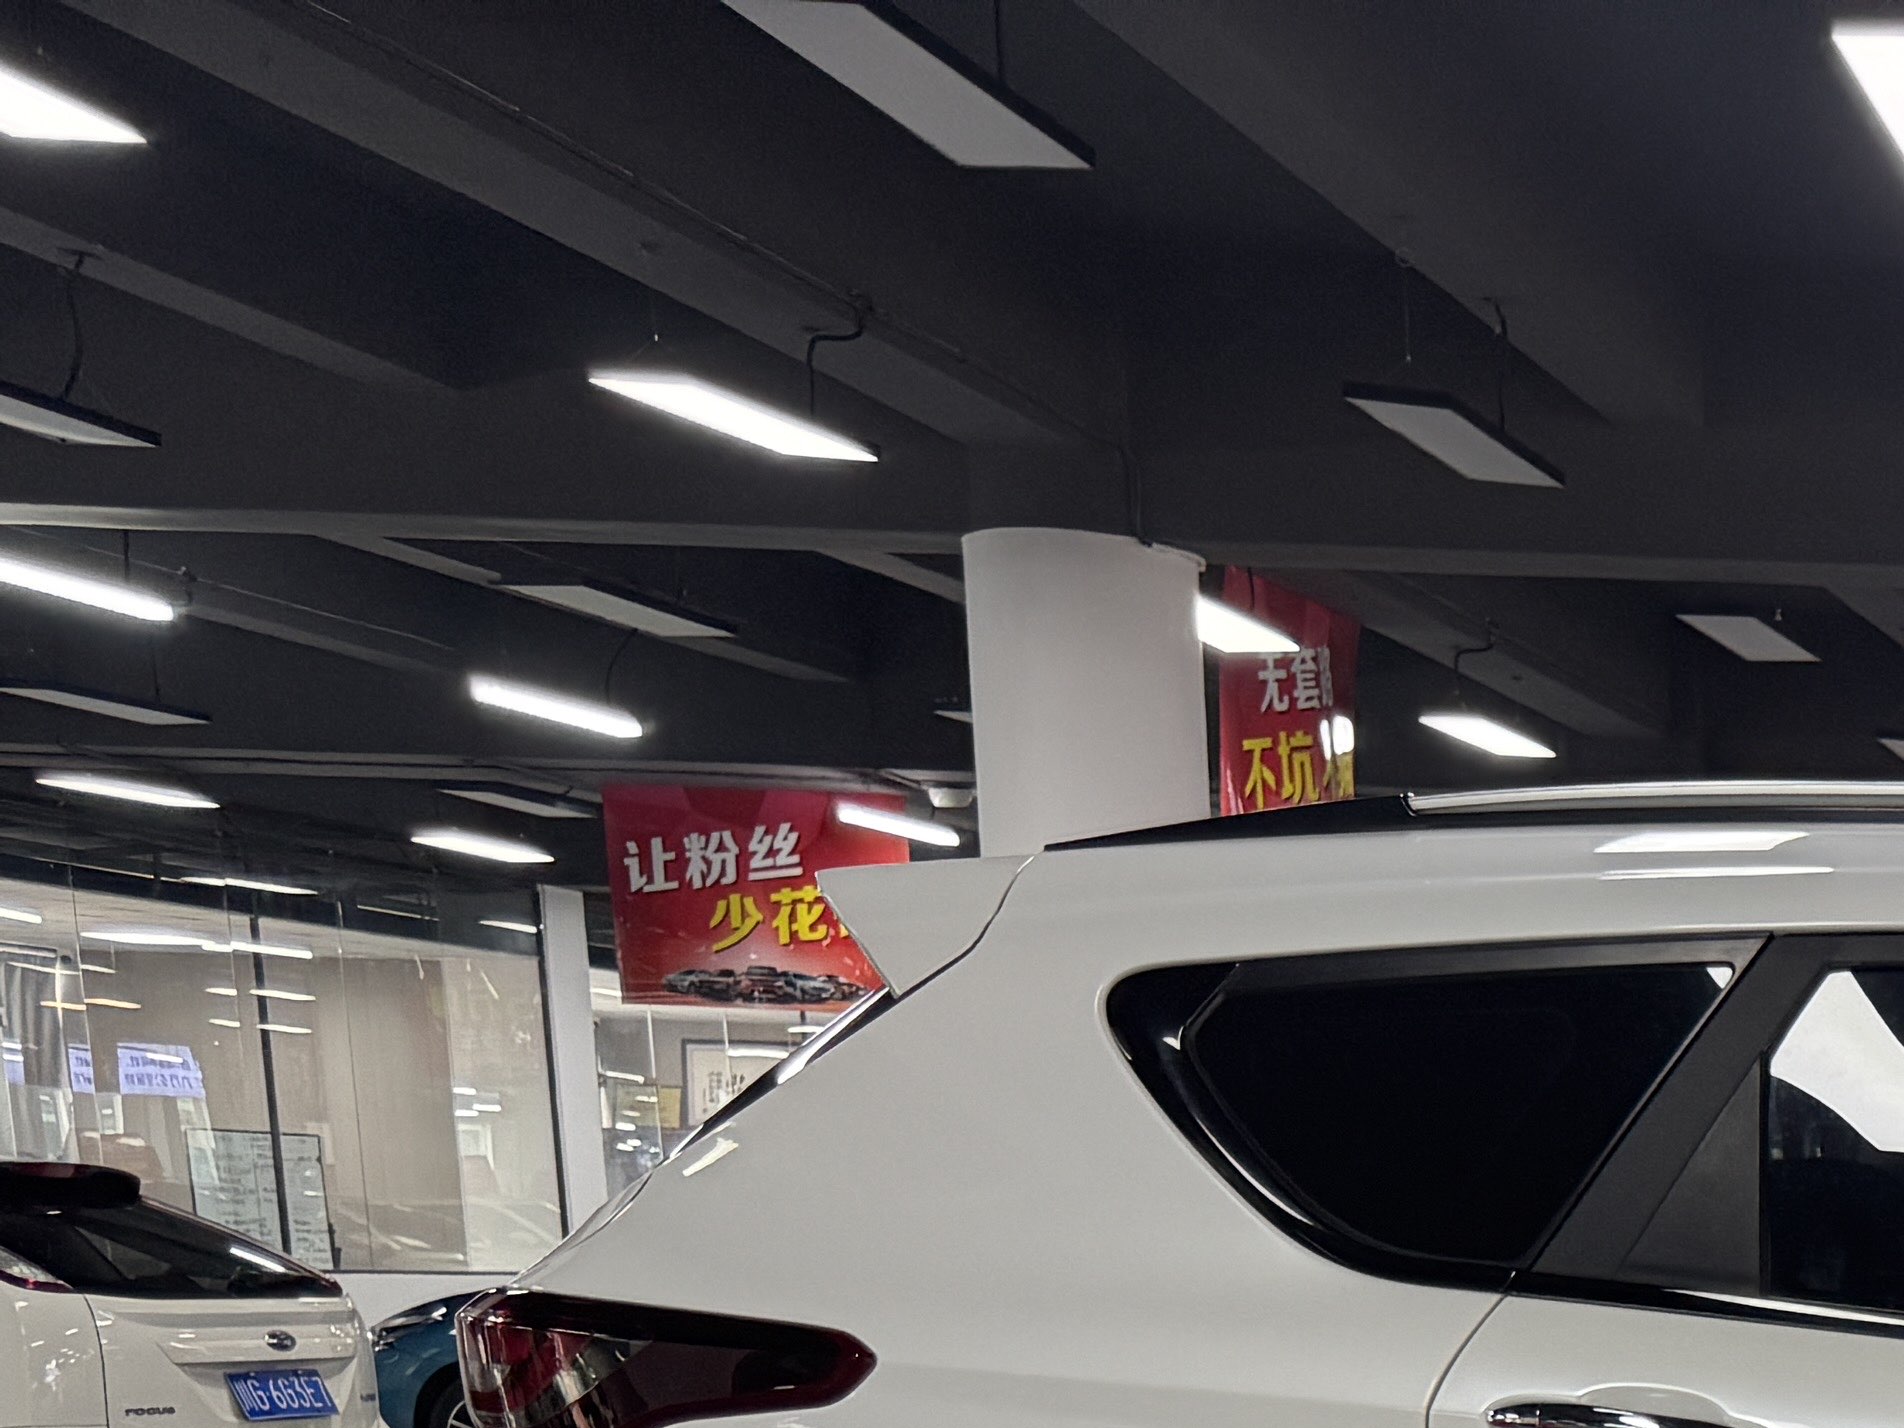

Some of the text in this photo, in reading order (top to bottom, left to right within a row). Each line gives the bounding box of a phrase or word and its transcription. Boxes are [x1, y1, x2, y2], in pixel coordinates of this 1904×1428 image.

[623, 822, 803, 893] 让粉丝
[709, 885, 850, 952] 少花
